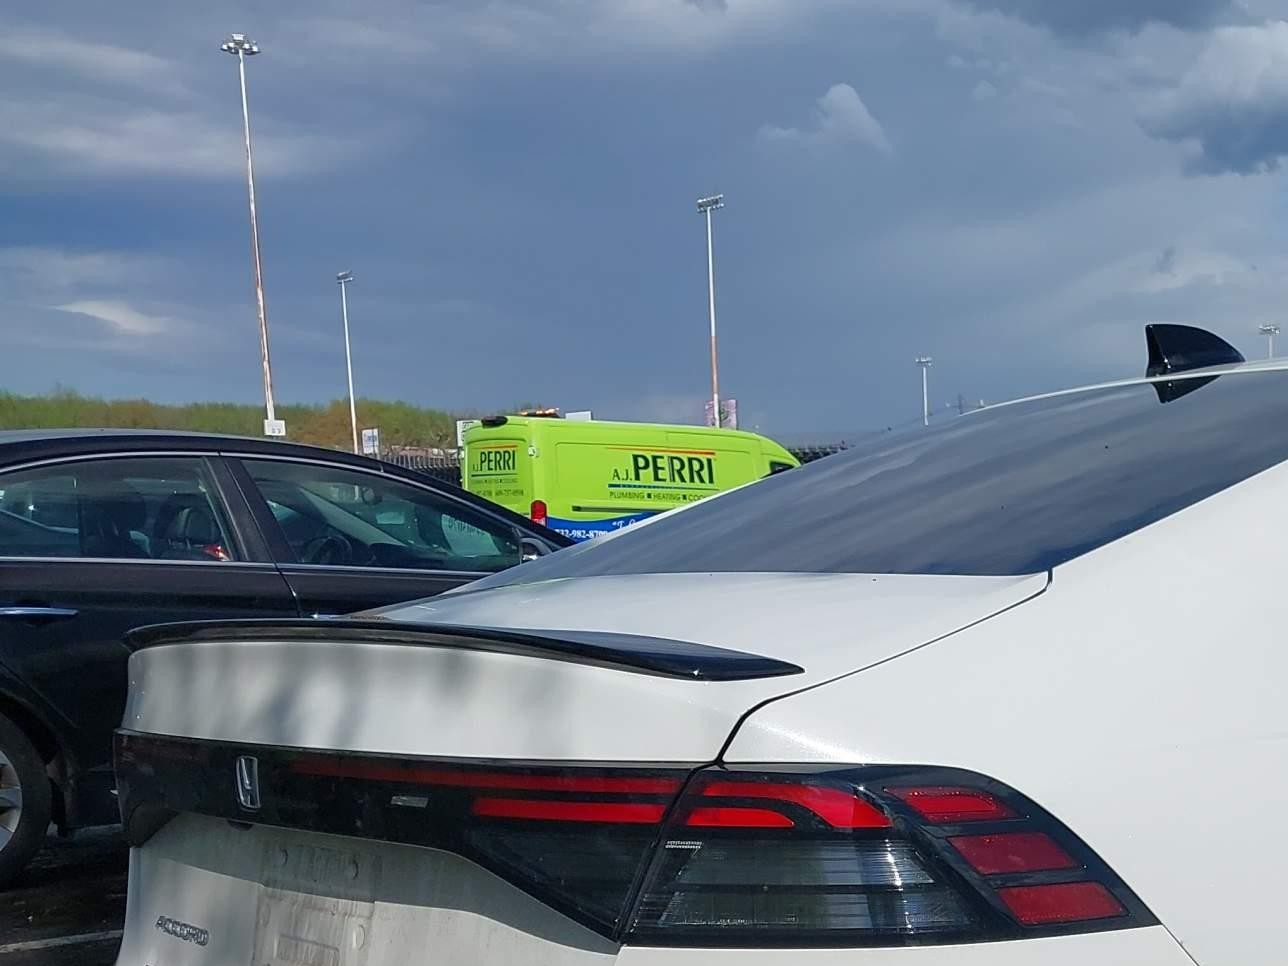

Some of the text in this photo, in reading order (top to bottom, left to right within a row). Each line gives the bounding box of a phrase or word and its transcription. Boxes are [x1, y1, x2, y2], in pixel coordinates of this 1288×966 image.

[479, 449, 515, 471] PERRI
[612, 453, 714, 484] A.J. PERRI
[609, 490, 645, 500] PLUMBING
[652, 492, 681, 501] HEATING
[155, 915, 209, 947] ACCORD
